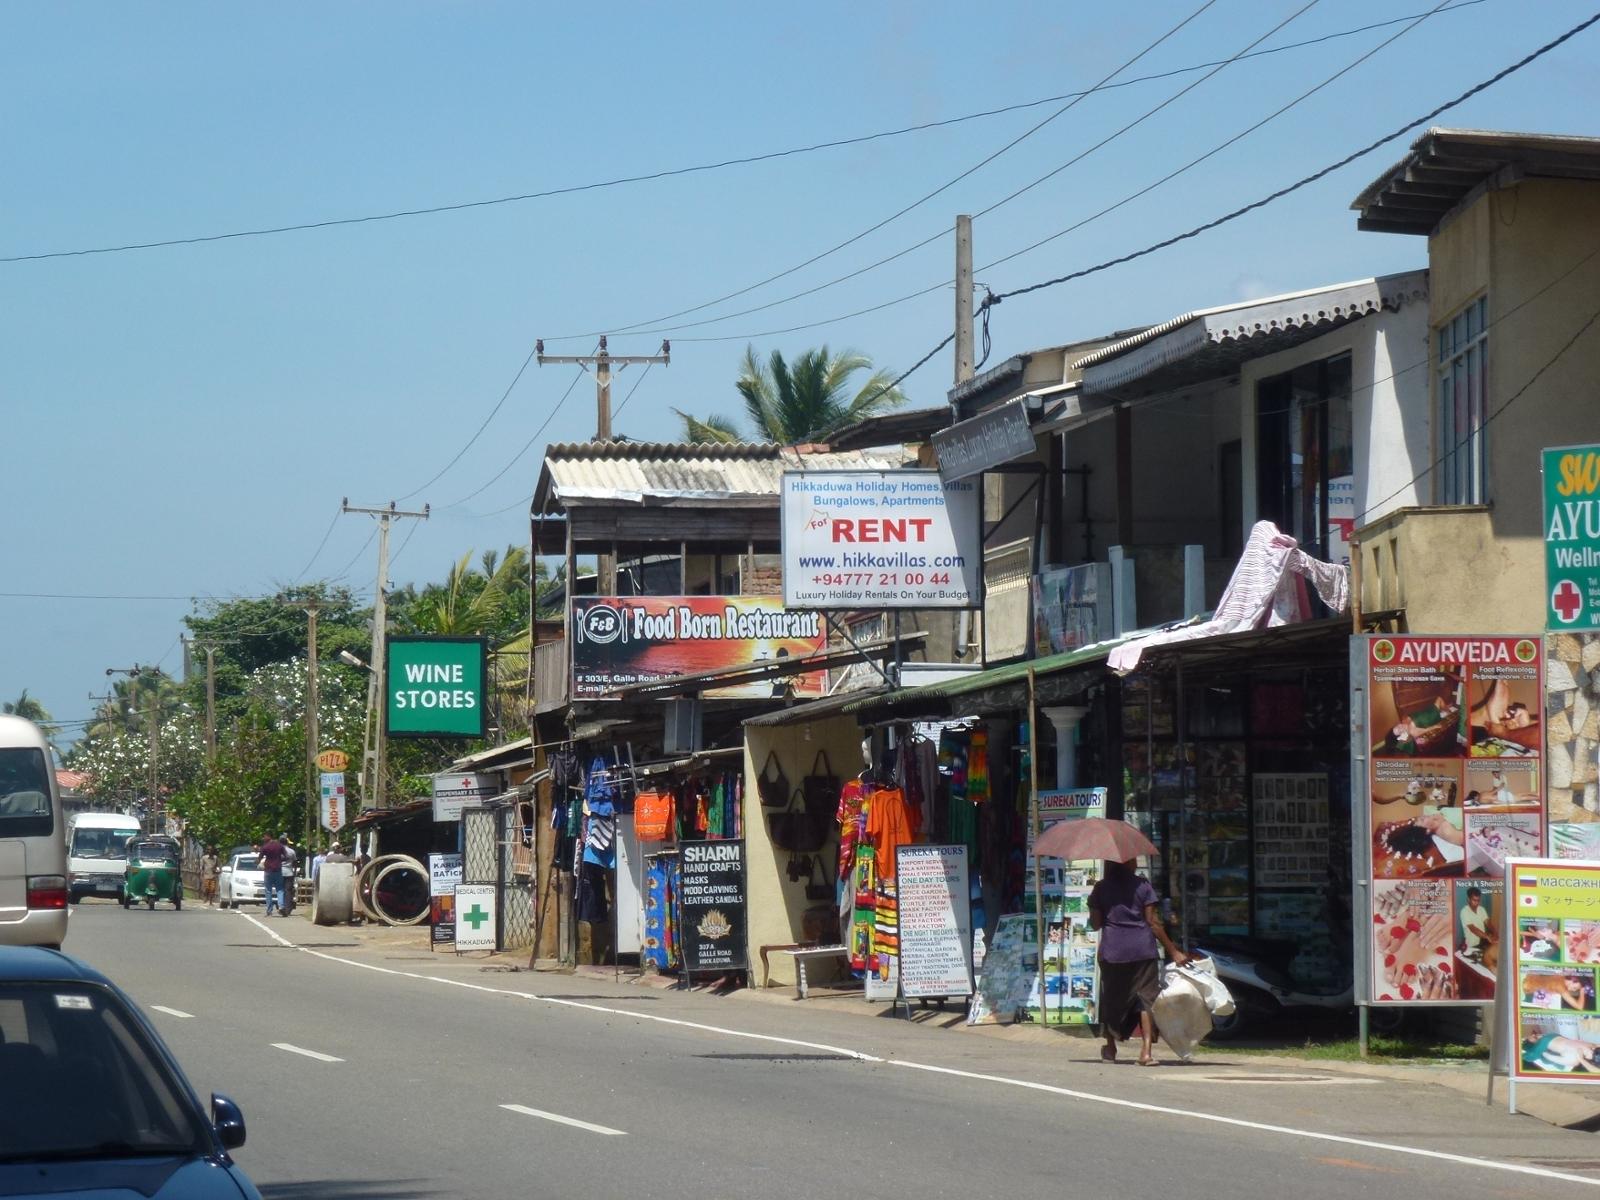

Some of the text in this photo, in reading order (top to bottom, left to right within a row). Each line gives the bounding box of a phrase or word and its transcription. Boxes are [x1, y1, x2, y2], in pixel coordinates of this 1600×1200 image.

[792, 482, 852, 492] Hikkaduwa
[856, 482, 897, 494] Holiday
[814, 496, 945, 509] Bungalows, Apartments
[811, 518, 932, 543] For RENT
[799, 552, 965, 568] www.hikkavillas.com
[812, 574, 950, 585] +94777 21 00 44
[796, 591, 826, 600] Luxury
[830, 590, 863, 600] Holiday
[865, 591, 898, 599] Rentals
[916, 591, 937, 599] Your
[939, 591, 970, 600] Budget
[590, 616, 614, 631] F&B
[633, 606, 820, 640] Food Born Restaurant
[1400, 642, 1510, 662] AYURVEDA
[405, 664, 464, 683] WINE
[614, 674, 636, 683] Galle
[395, 690, 476, 709] STORES
[685, 846, 740, 862] SHARM
[902, 847, 964, 857] SUREKA TOURS
[684, 862, 741, 874] HANDI CRAFTS
[684, 876, 709, 885] MASKS
[684, 885, 738, 895] WOOD CARVINGS
[685, 895, 743, 905] LEATHER SANDALS
